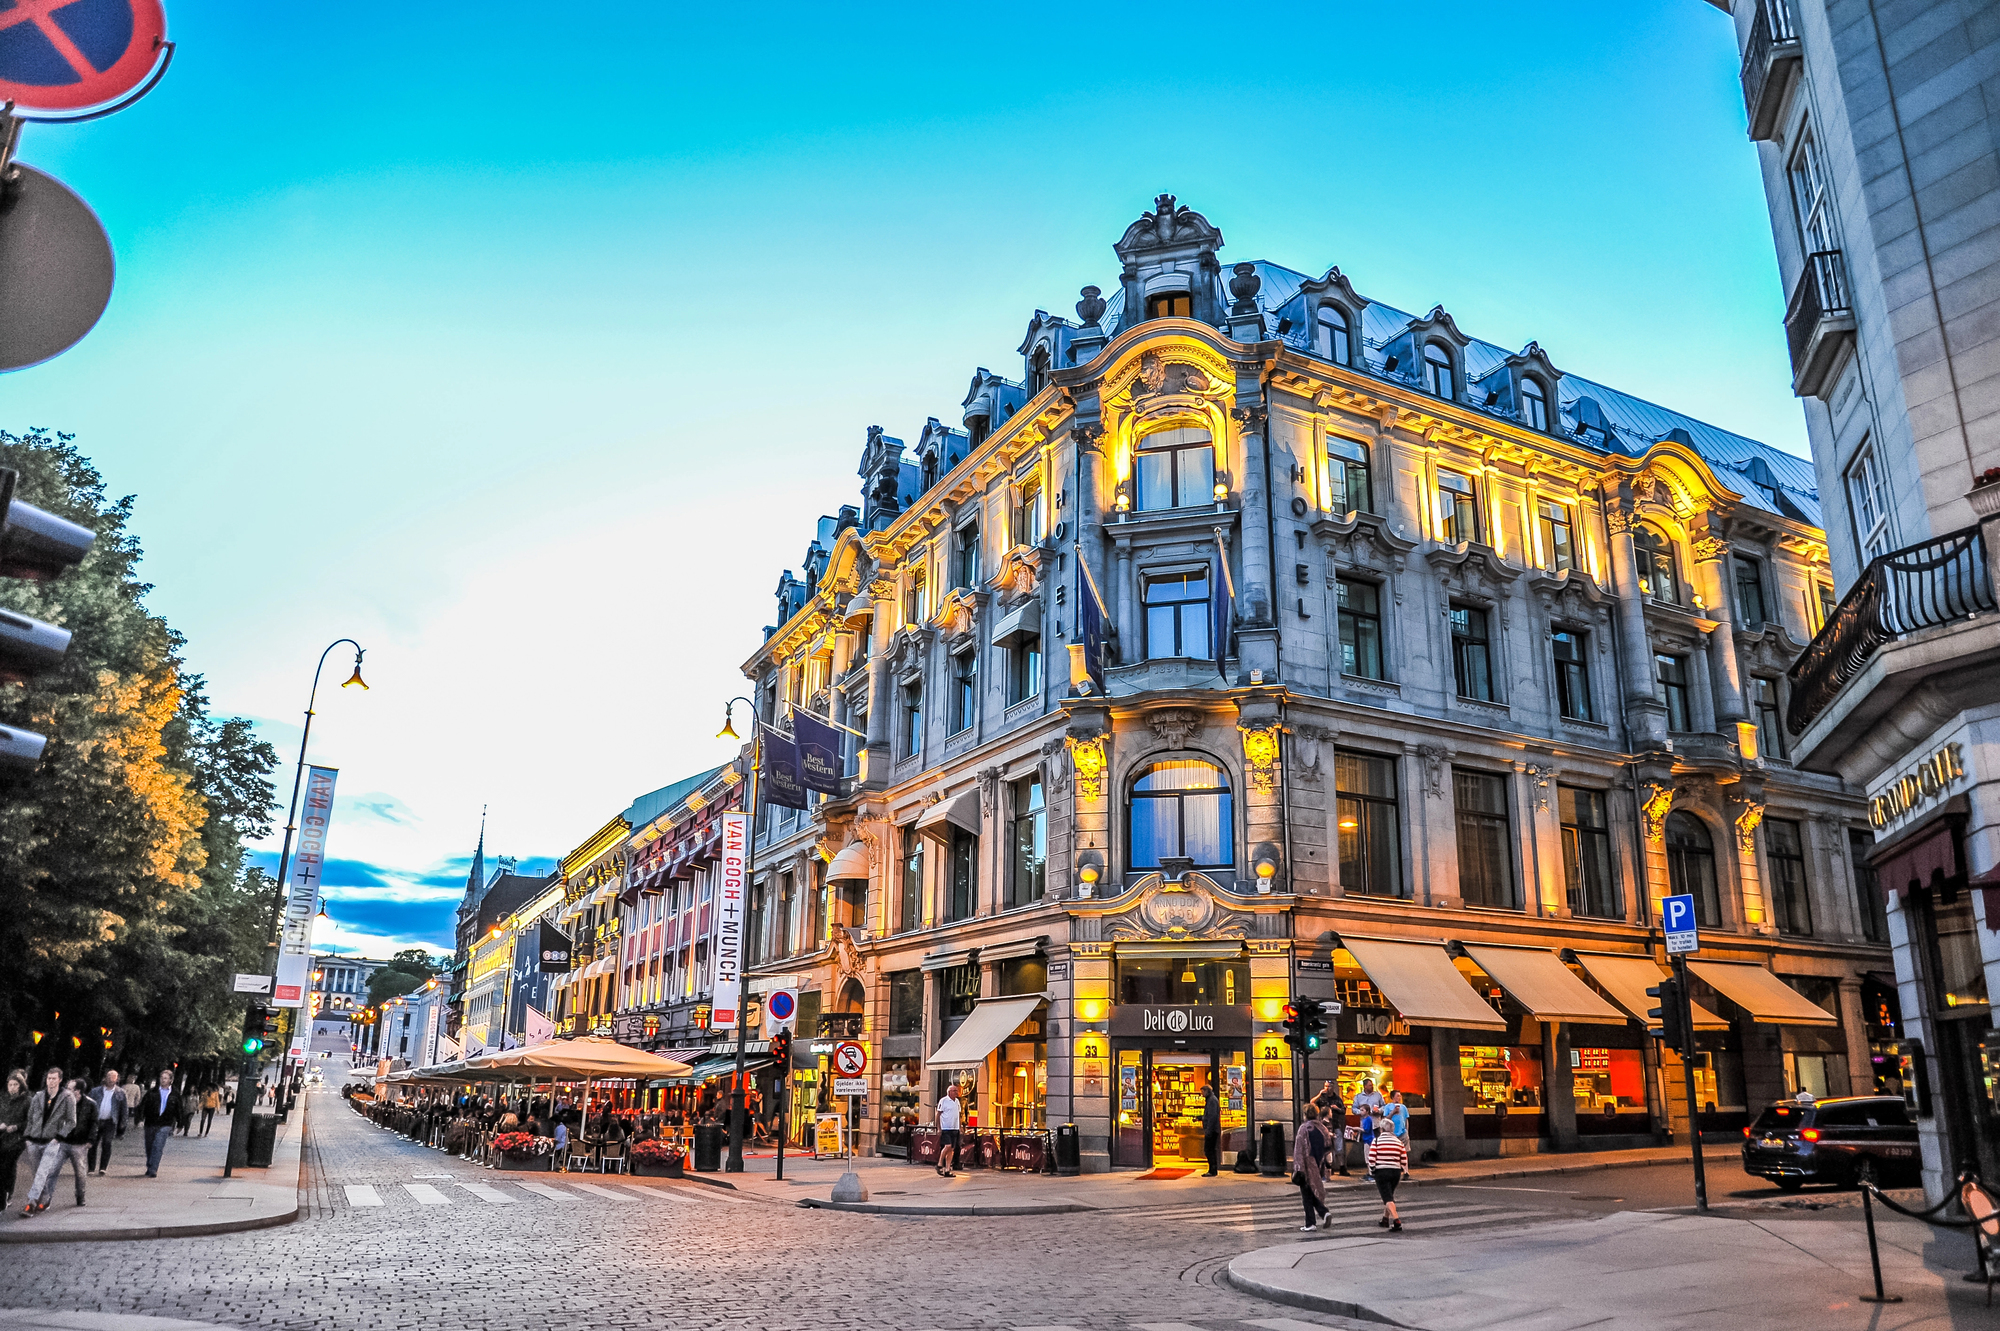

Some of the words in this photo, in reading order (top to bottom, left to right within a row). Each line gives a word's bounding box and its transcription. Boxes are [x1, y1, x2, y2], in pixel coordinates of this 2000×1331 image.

[1289, 463, 1311, 618] HOTEL
[1055, 489, 1066, 637] HOTEL
[806, 752, 825, 767] Best
[775, 769, 793, 783] Best
[1868, 773, 1920, 831] GRAND
[727, 820, 743, 850] VAN
[724, 857, 742, 899] GOGH
[1154, 897, 1177, 908] ANNO
[1180, 897, 1200, 908] DOM
[1669, 901, 1686, 928] P
[719, 921, 739, 982] MUNCH
[1144, 1009, 1165, 1031] Deli
[1189, 1009, 1214, 1031] Luca
[1356, 1013, 1374, 1034] Deli
[1084, 1045, 1098, 1058] 33
[1264, 1046, 1279, 1060] 33
